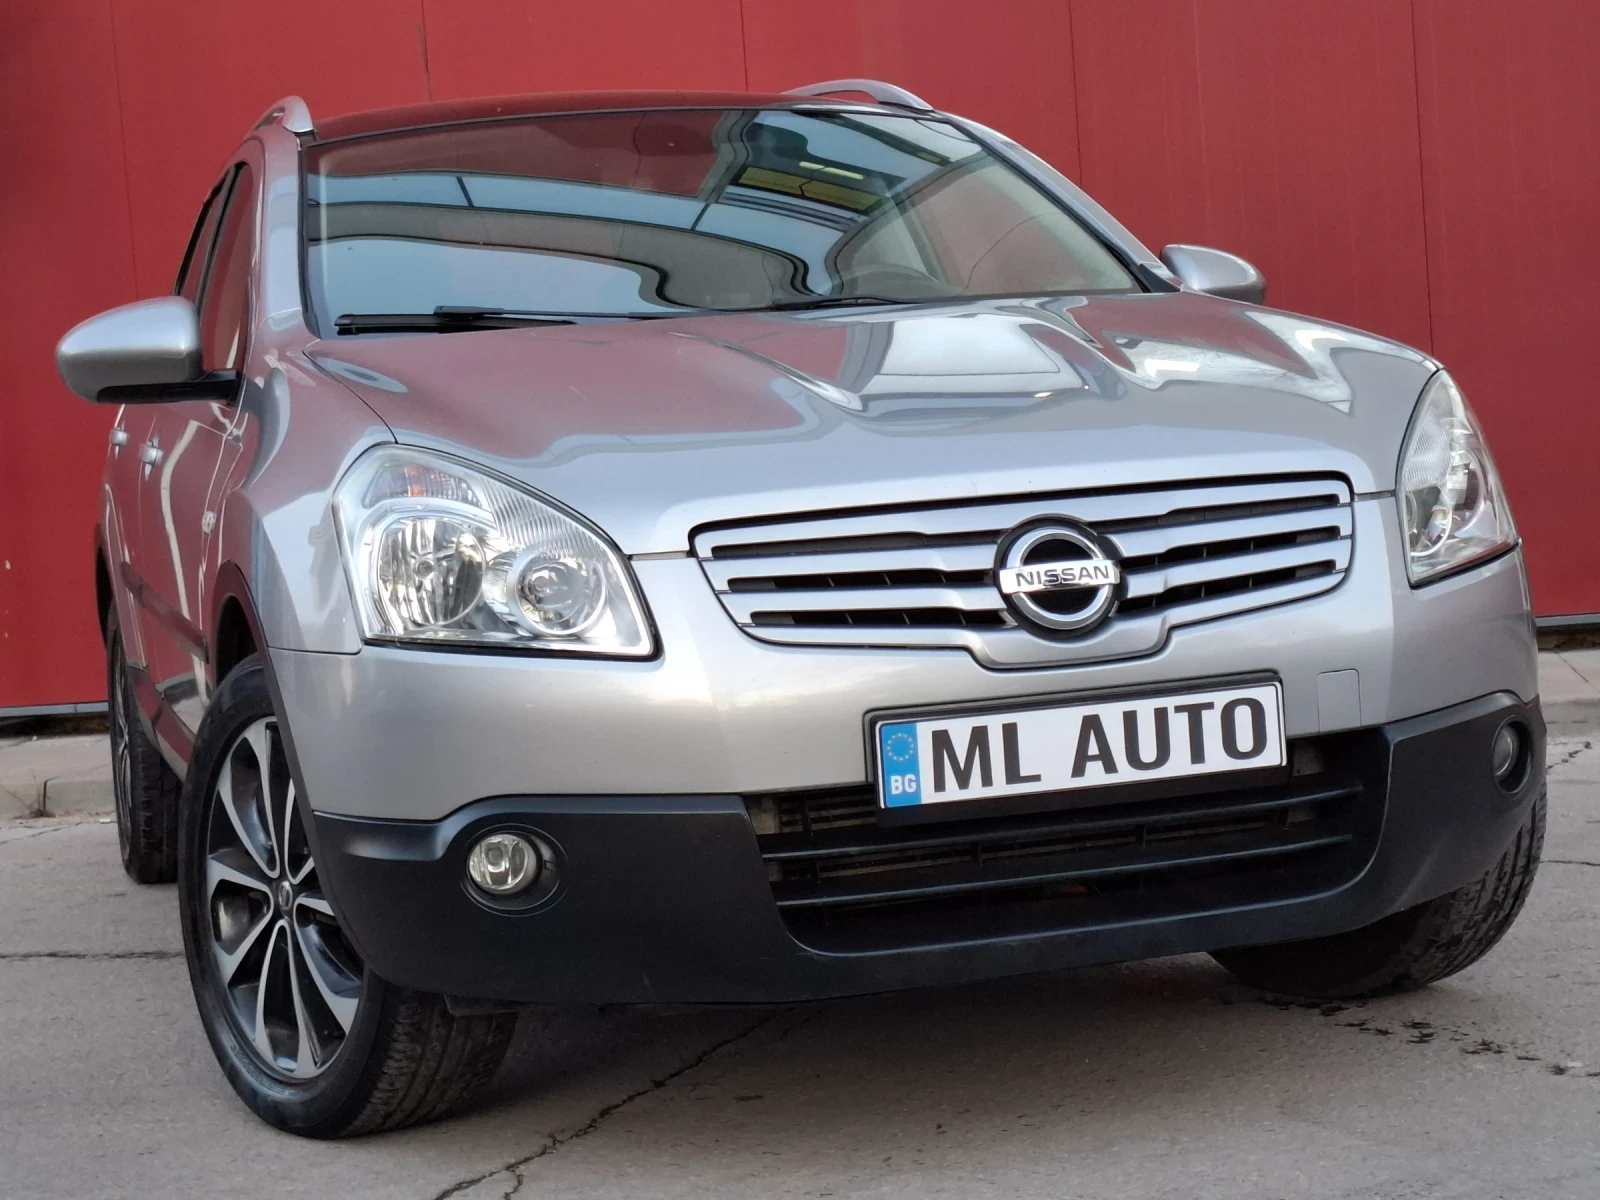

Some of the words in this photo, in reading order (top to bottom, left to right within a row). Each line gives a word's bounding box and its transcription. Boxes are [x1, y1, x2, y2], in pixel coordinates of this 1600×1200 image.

[1015, 565, 1110, 587] NISSAN
[931, 722, 1042, 793] ML
[1070, 697, 1268, 778] AUTO
[890, 774, 917, 795] BG
